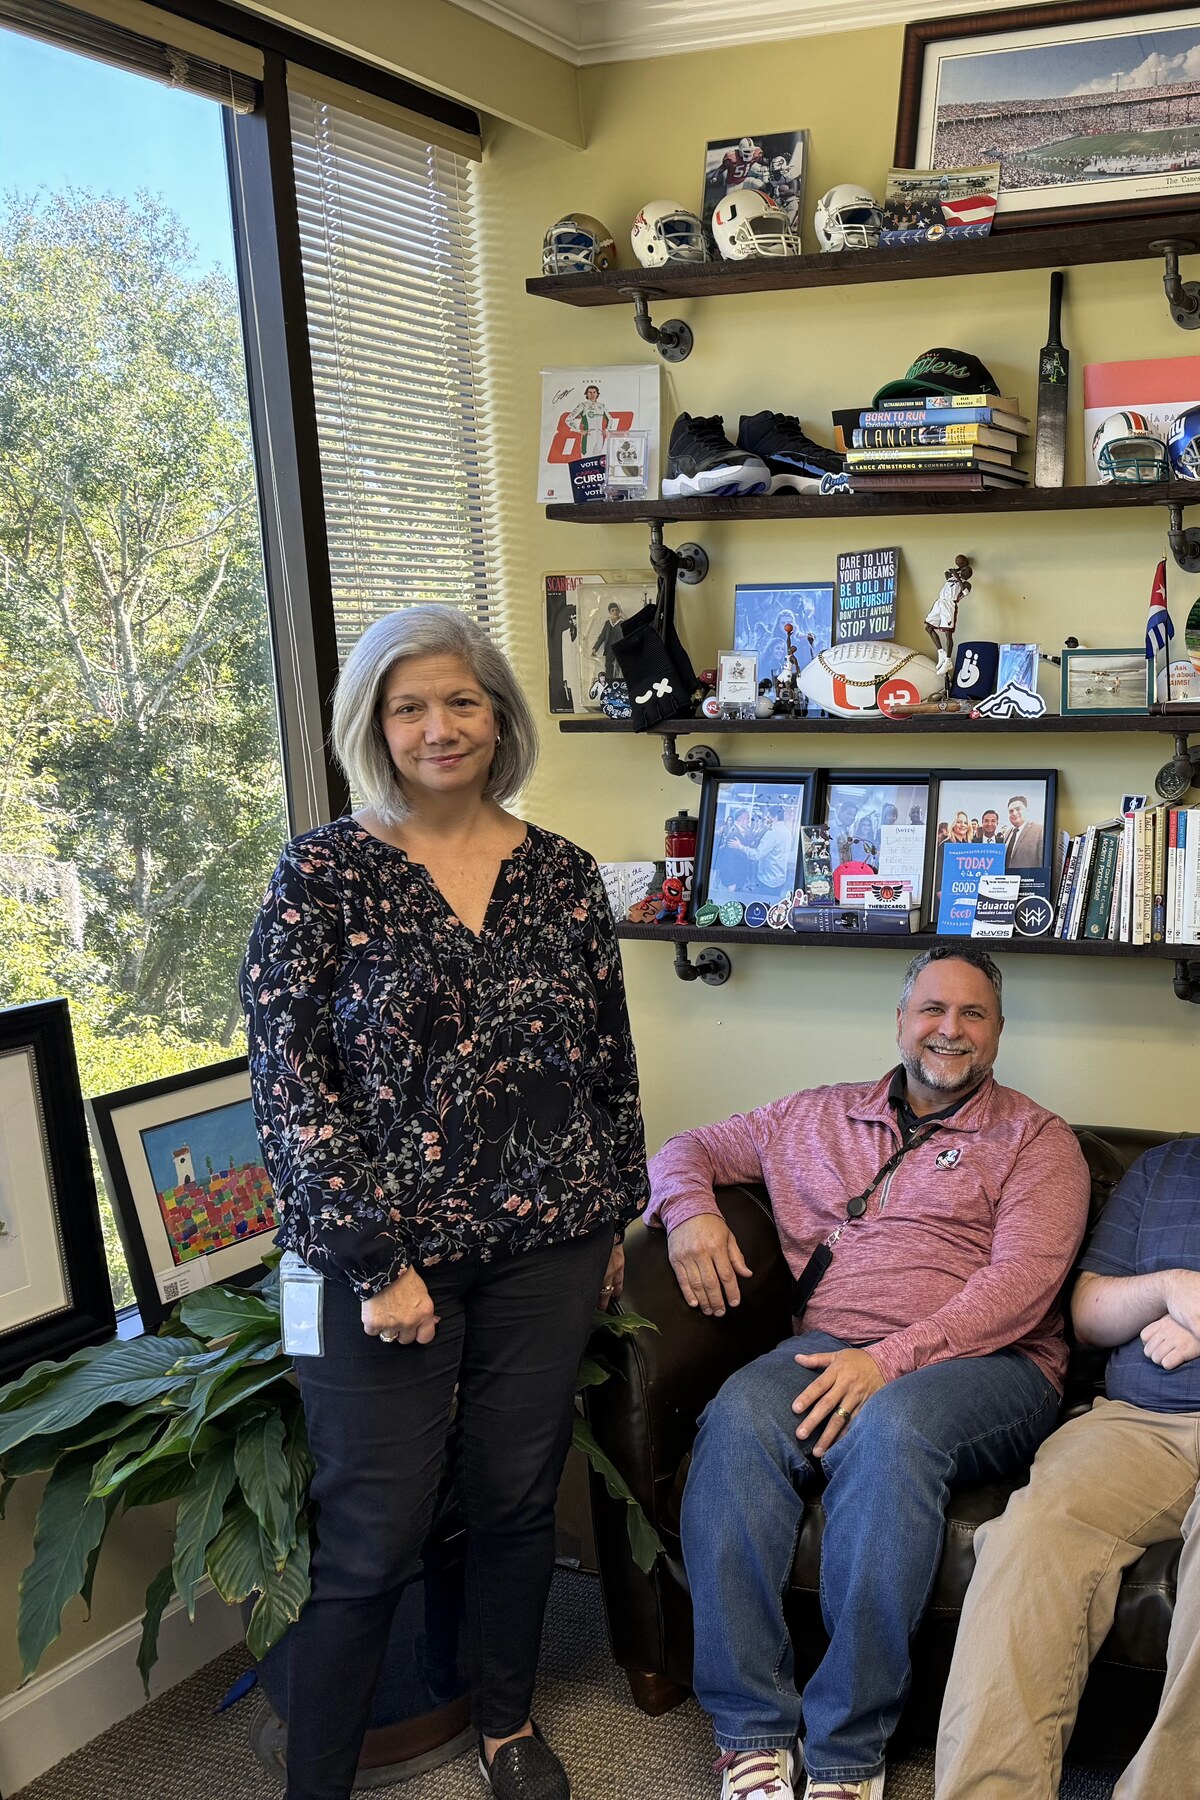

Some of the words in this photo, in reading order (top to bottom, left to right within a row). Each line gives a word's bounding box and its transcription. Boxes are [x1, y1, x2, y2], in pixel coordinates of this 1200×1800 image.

[865, 412, 890, 421] BORN
[893, 412, 904, 420] TO
[906, 411, 926, 420] RUN
[865, 428, 917, 448] LANCE
[840, 556, 860, 570] DARE
[863, 554, 873, 567] TO
[876, 551, 894, 565] LIVE
[840, 569, 860, 583] YOUR
[863, 564, 894, 580] DREAMS
[840, 584, 851, 597] BE
[856, 580, 879, 595] BOLD
[884, 578, 894, 591] IN
[840, 596, 860, 610] YOUR
[861, 591, 894, 608] PURSUIT
[840, 610, 856, 620] DON'T
[859, 608, 868, 618] LET
[870, 605, 893, 616] ANYONE
[841, 620, 866, 638] STOP
[870, 616, 892, 633] YOU.
[1100, 838, 1108, 863] Modern
[956, 858, 994, 870] TODAY
[952, 881, 976, 893] GOOD
[1094, 864, 1104, 901] Portuguese
[977, 902, 1015, 910] Eduardo
